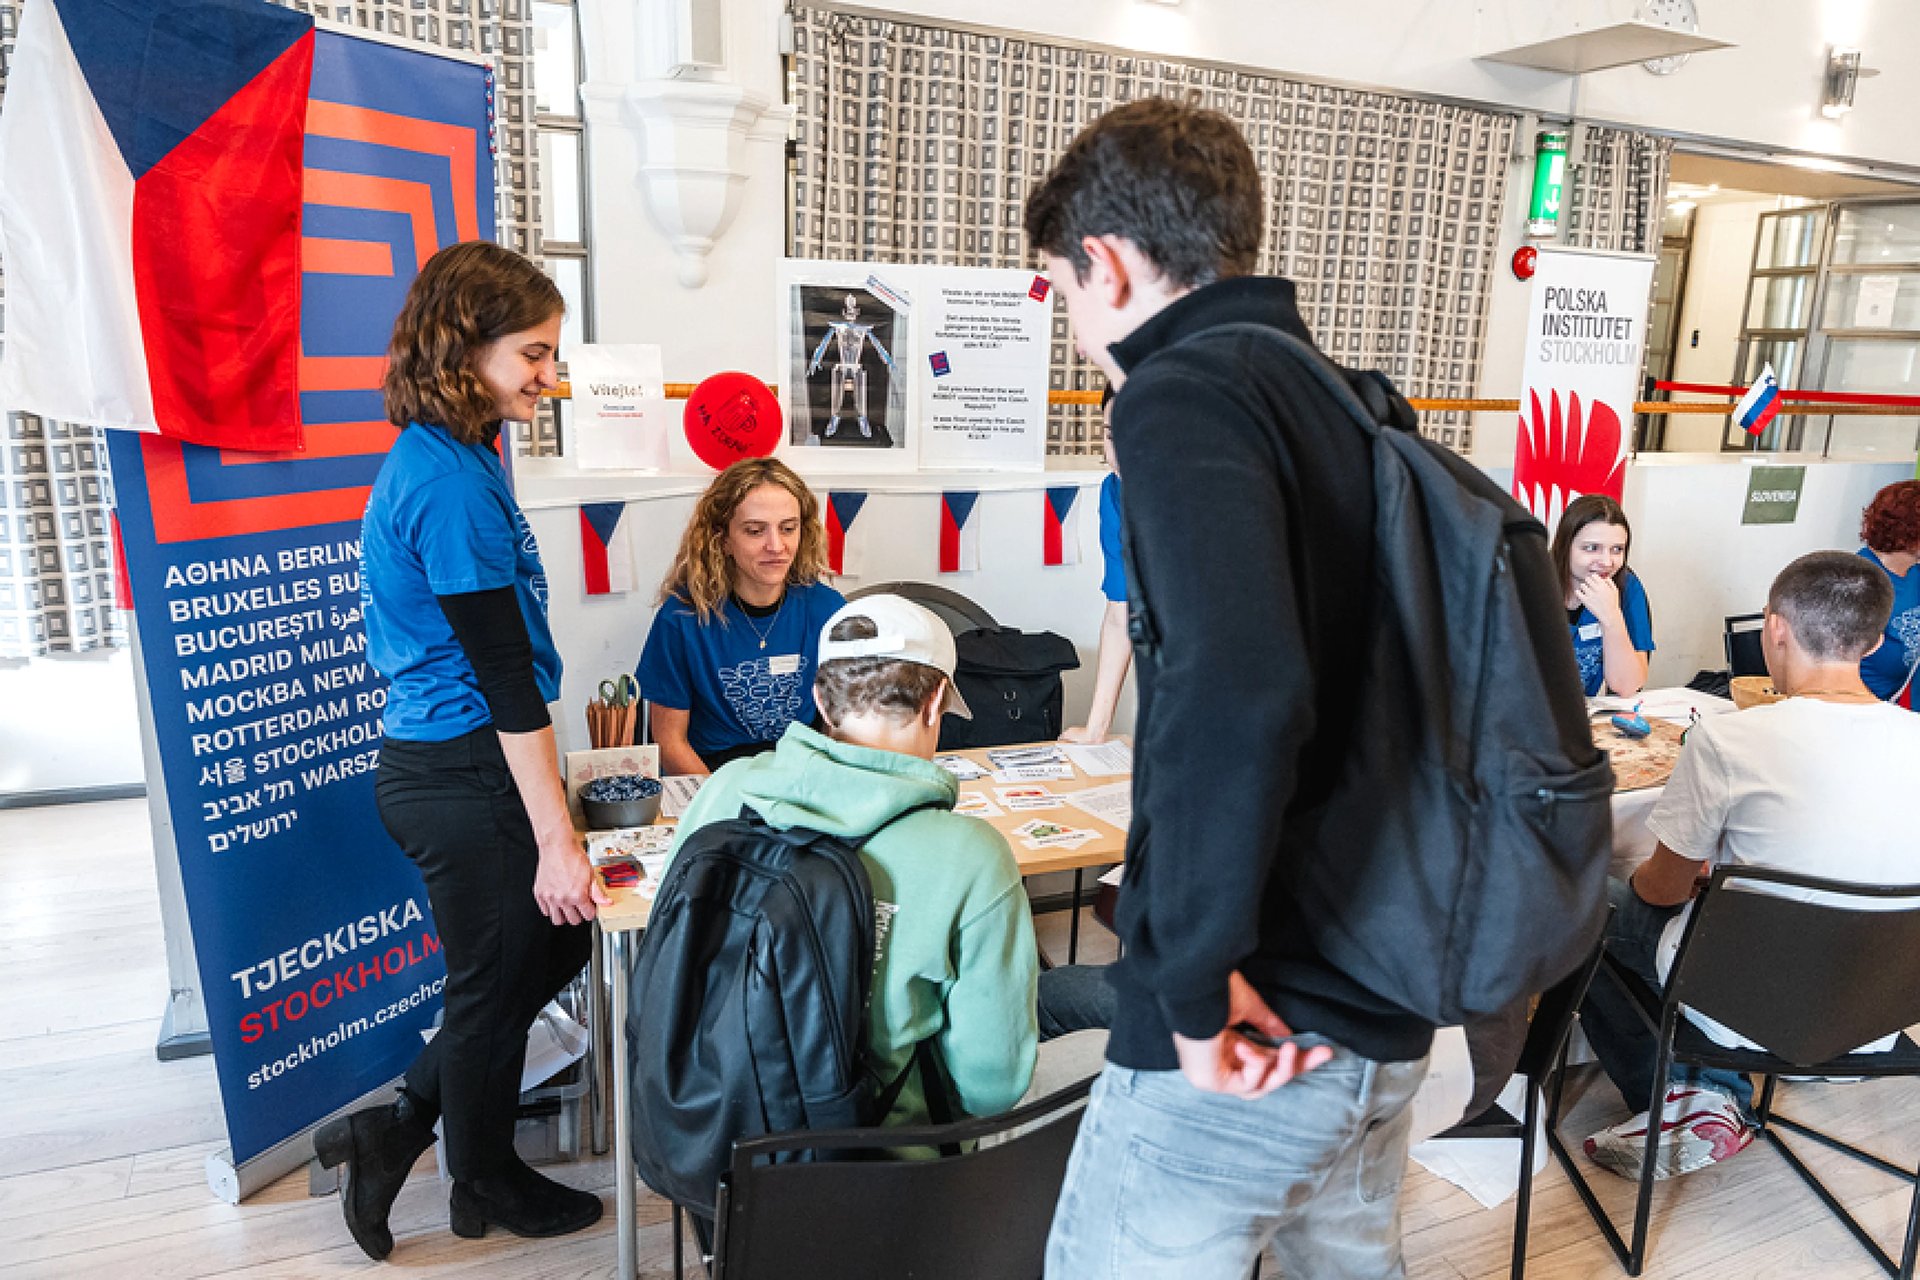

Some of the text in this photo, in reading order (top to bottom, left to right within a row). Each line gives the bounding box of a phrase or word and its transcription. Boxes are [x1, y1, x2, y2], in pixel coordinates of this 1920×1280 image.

[1544, 286, 1608, 313] POLSKA
[1542, 313, 1633, 340] INSTITUTET
[1539, 339, 1637, 365] STOCKHOLM
[277, 540, 360, 573] BERLIN
[168, 578, 322, 623] BRUXELLES
[179, 650, 292, 690] MADRID
[313, 662, 367, 693] NEW
[191, 698, 349, 757] ROTTERDAM
[199, 758, 247, 787] 서울
[203, 790, 262, 822] אביב
[207, 809, 298, 853] ירושלים
[231, 897, 423, 999] TJECKISKA
